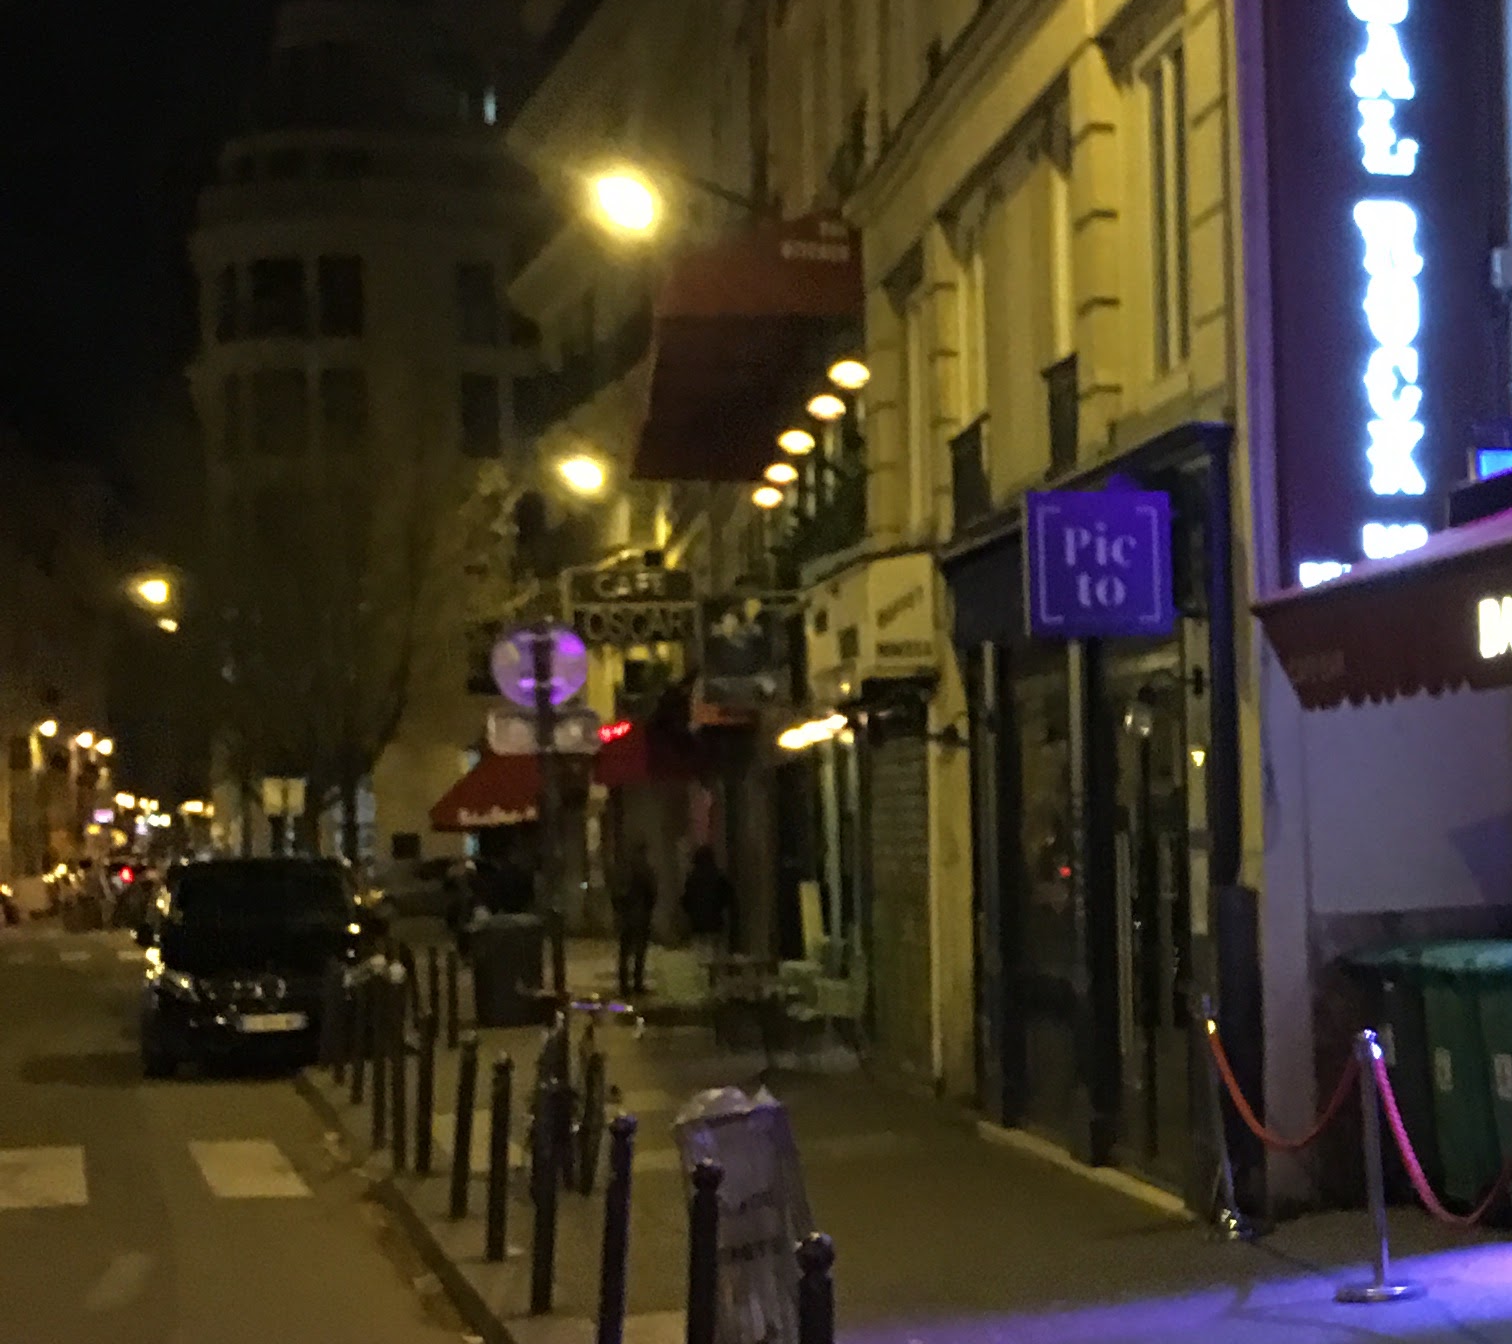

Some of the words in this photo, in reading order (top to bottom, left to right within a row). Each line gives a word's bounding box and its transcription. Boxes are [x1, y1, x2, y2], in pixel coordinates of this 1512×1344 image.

[1353, 199, 1427, 495] ROCK
[1063, 521, 1138, 568] Pic
[1076, 570, 1127, 608] to
